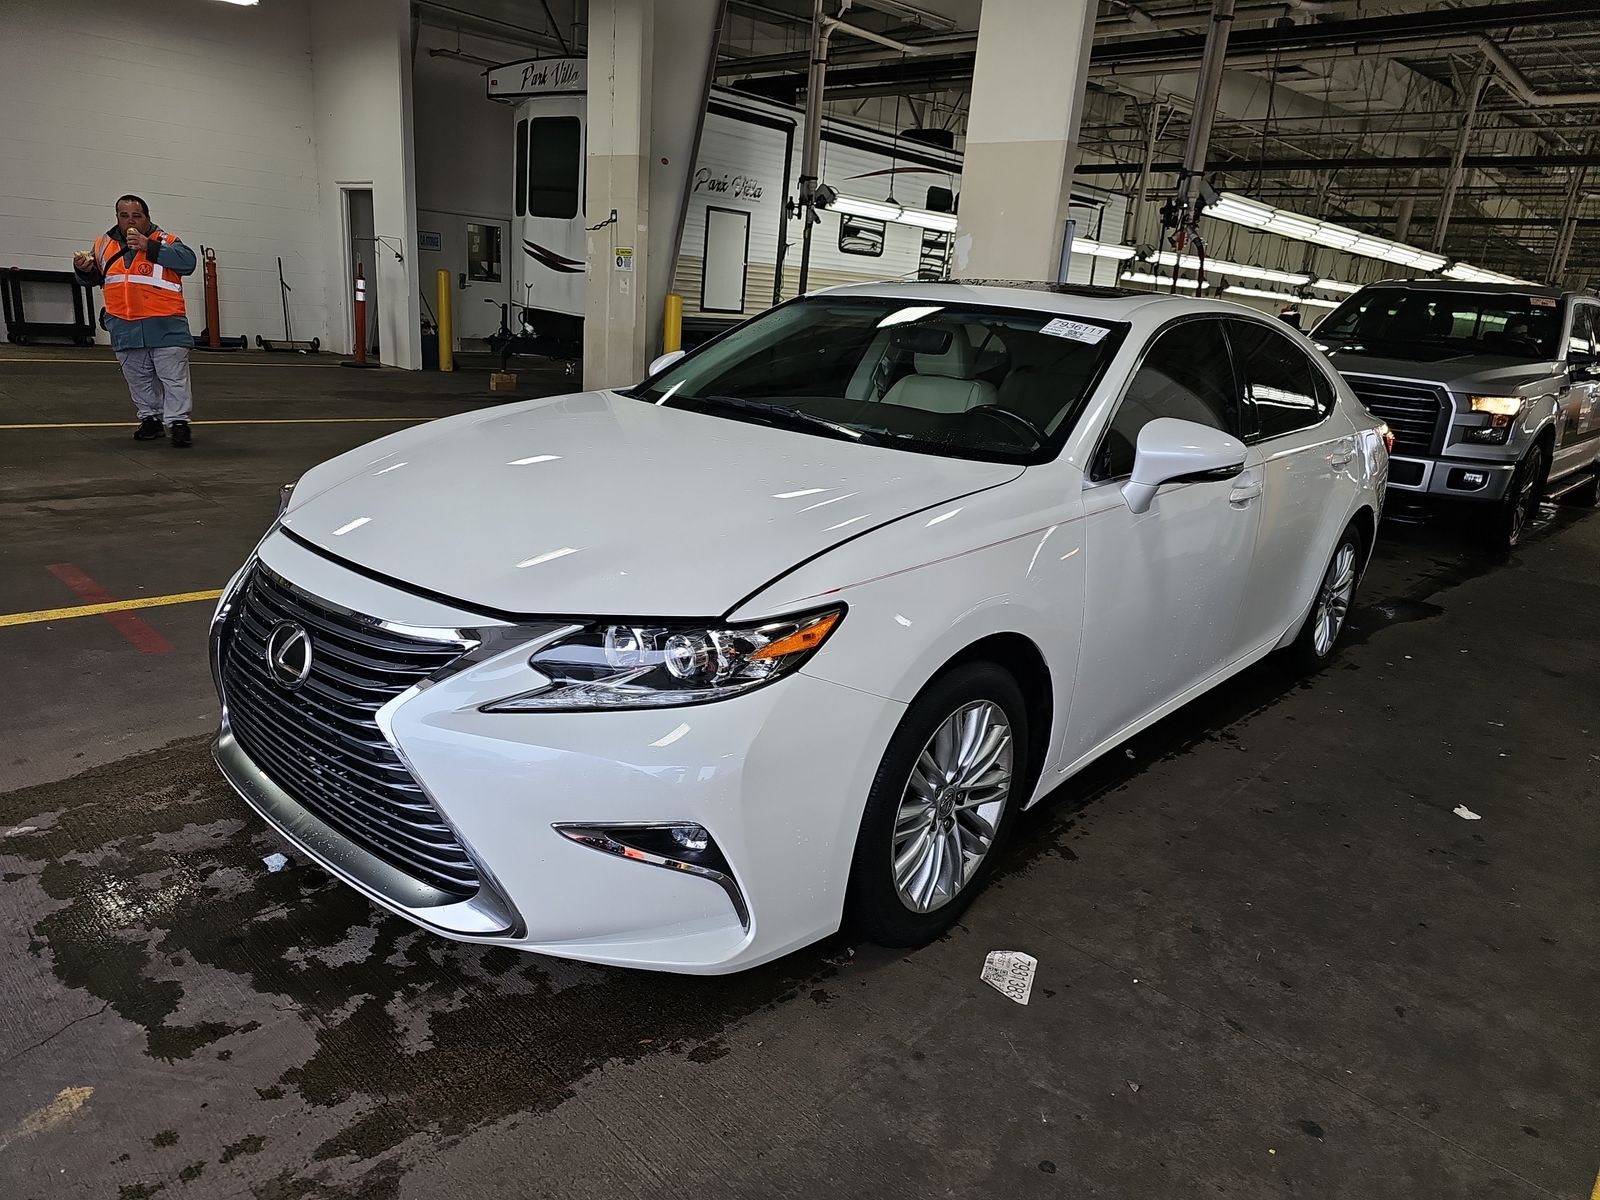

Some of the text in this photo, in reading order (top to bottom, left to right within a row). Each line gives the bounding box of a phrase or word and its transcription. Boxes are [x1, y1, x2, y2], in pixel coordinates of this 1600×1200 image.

[521, 60, 580, 91] Park Villa
[1053, 320, 1103, 334] 7936111
[1006, 957, 1031, 999] 7931383
